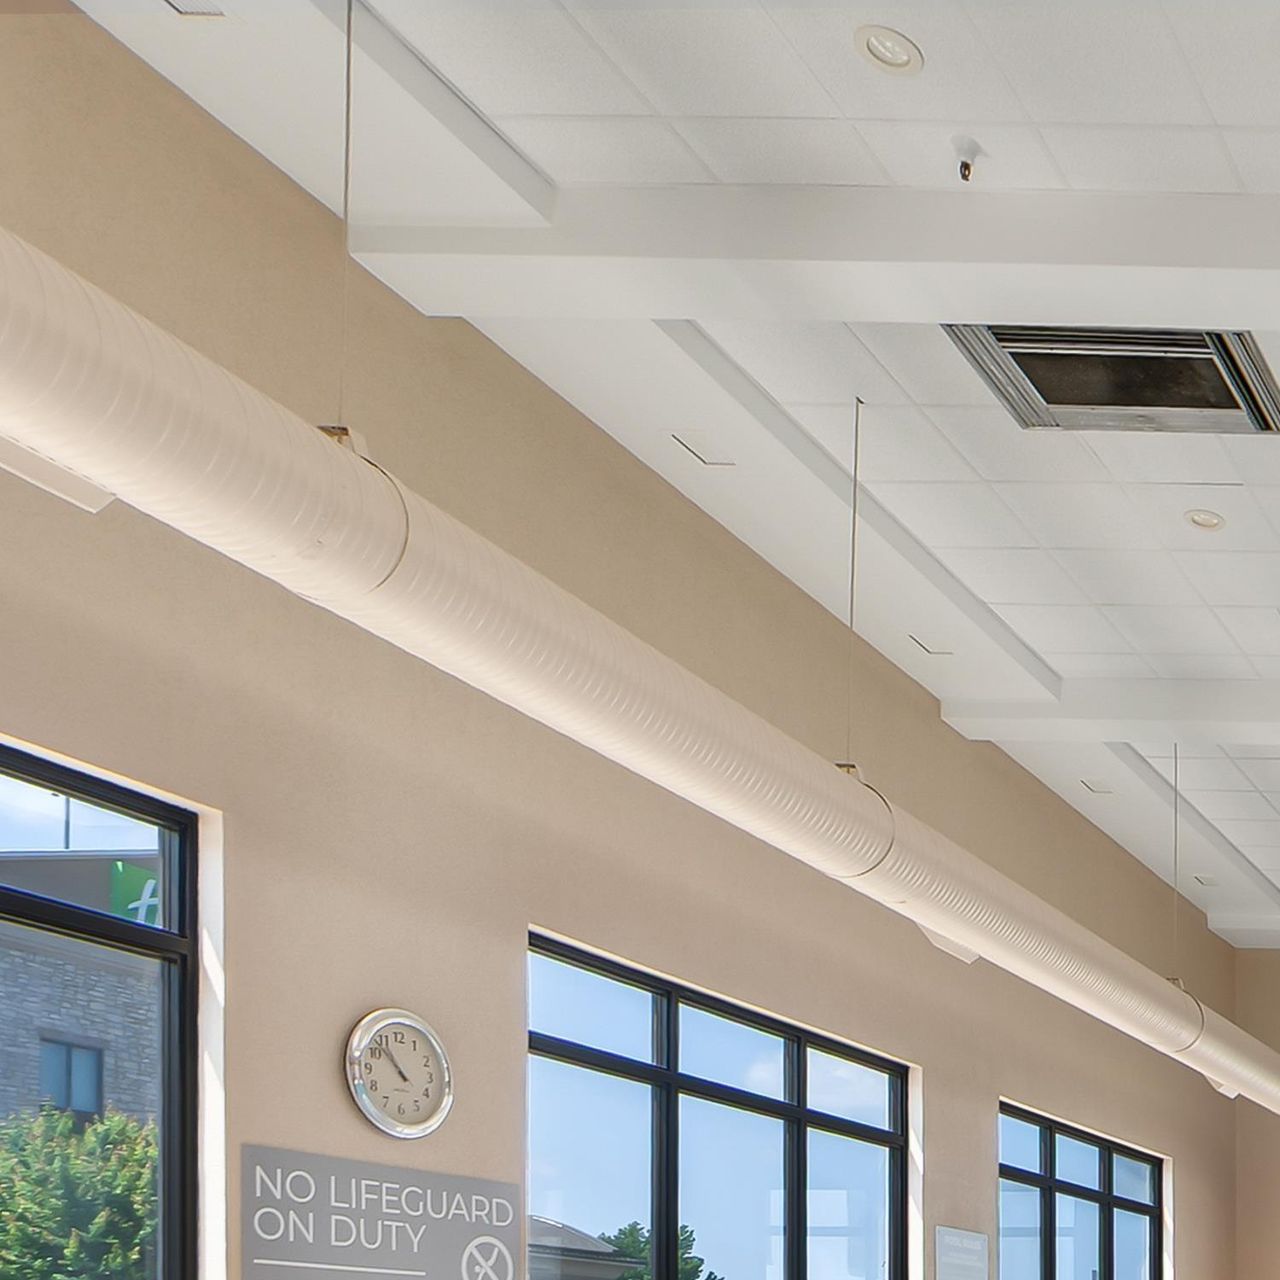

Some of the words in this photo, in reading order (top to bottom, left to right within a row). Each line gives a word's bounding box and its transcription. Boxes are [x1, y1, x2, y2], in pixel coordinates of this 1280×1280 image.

[393, 1031, 405, 1045] 12
[411, 1040, 417, 1052] 1
[369, 1046, 382, 1060] 10
[423, 1055, 430, 1067] 2
[364, 1062, 373, 1075] 9
[427, 1072, 434, 1084] 3
[370, 1079, 378, 1092] 8
[422, 1087, 430, 1099] 4
[382, 1095, 389, 1108] 7
[413, 1099, 420, 1112] 5
[397, 1103, 406, 1115] 6
[255, 1165, 316, 1203] NO
[330, 1175, 514, 1227] LIFEGUARD
[253, 1207, 314, 1243] ON
[330, 1214, 427, 1253] DUTY
